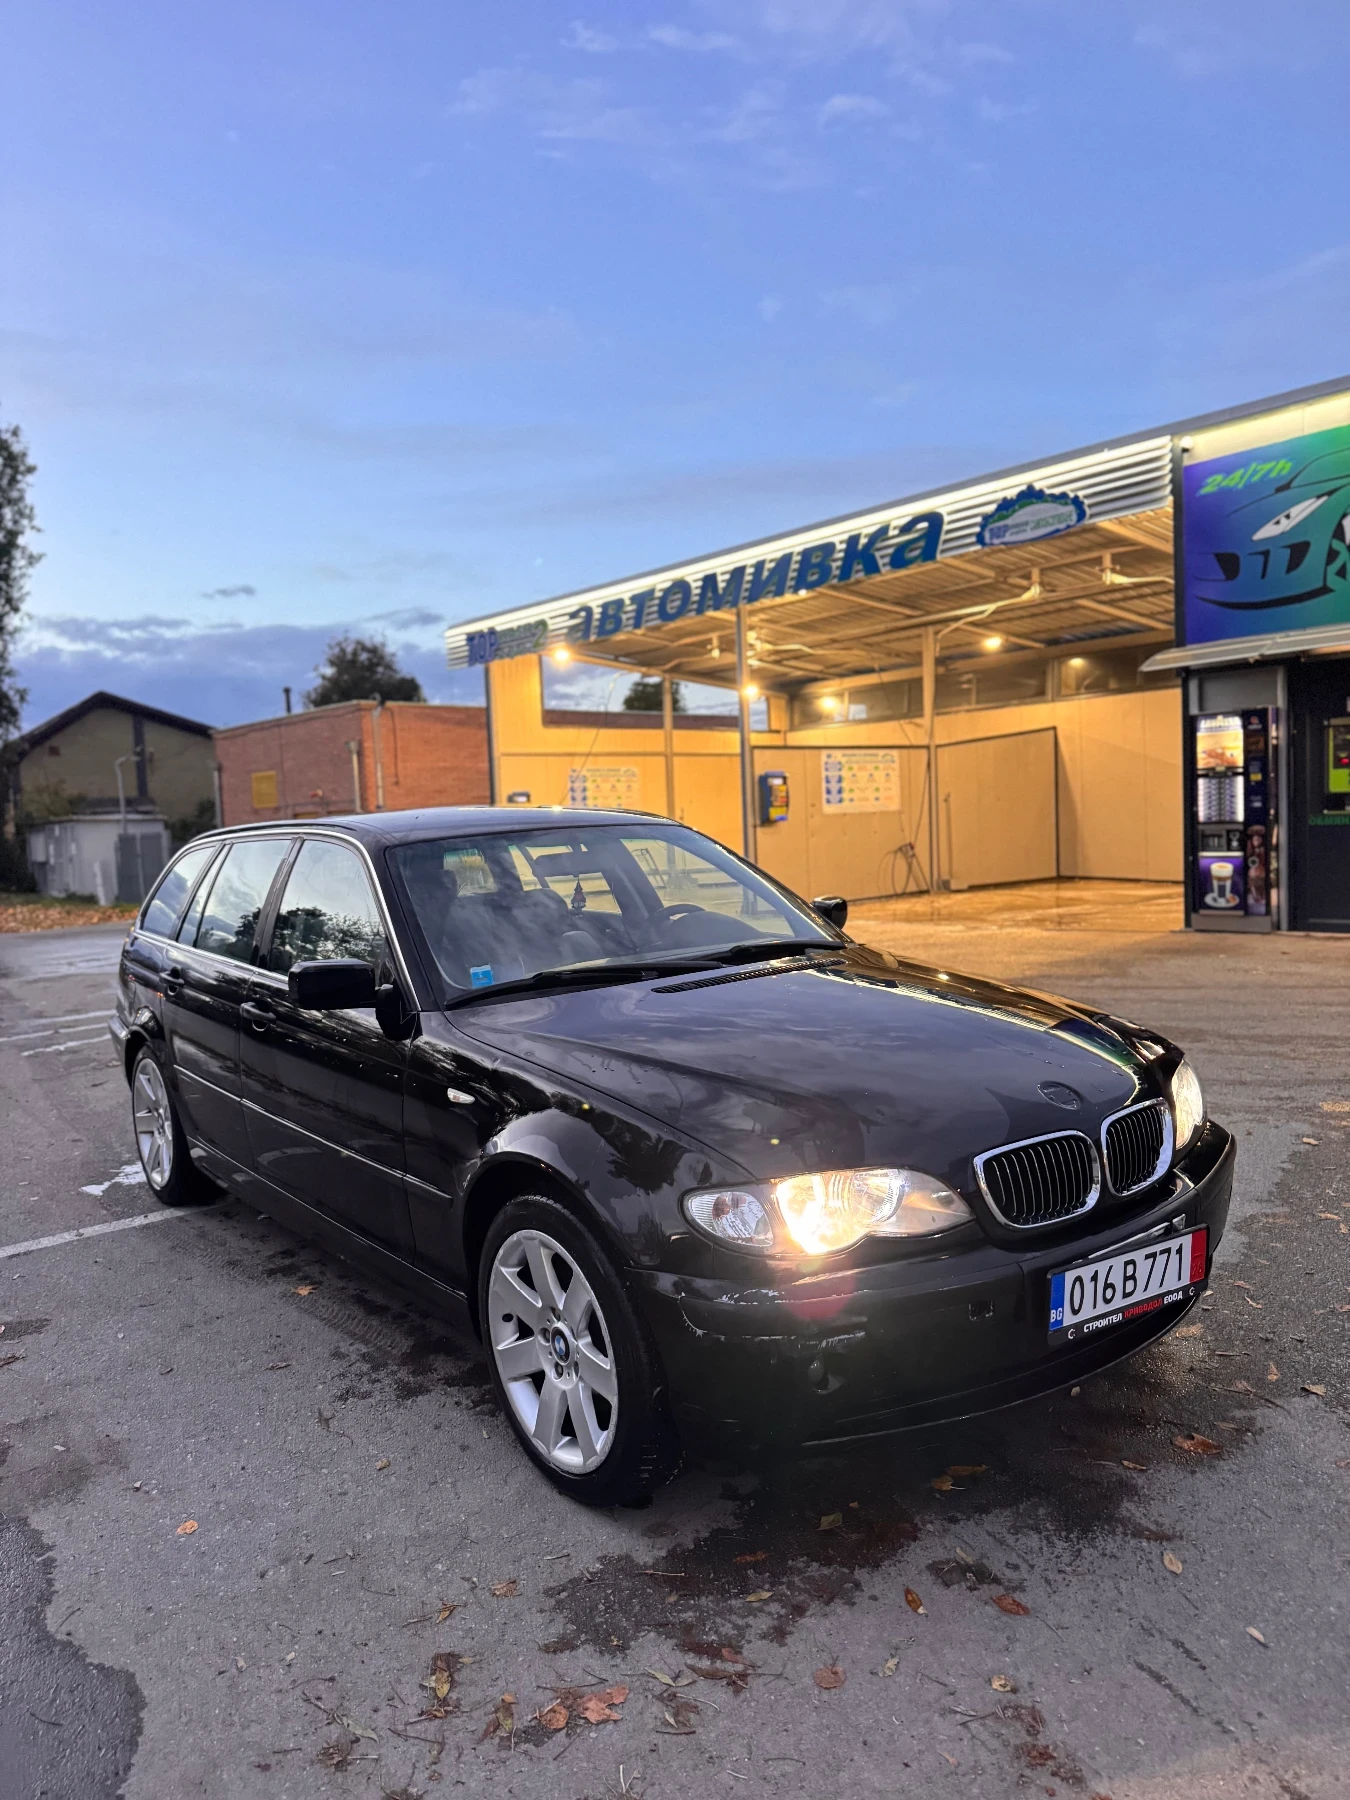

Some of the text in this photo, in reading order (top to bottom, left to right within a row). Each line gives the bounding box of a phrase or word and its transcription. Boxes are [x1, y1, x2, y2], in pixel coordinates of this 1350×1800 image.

[1199, 459, 1293, 495] 24/7h
[1069, 1242, 1183, 1316] 016B771
[1050, 1308, 1063, 1323] BG
[1083, 1312, 1123, 1333] СТРОИТЕЛ
[1163, 1290, 1183, 1305] ЕООД
